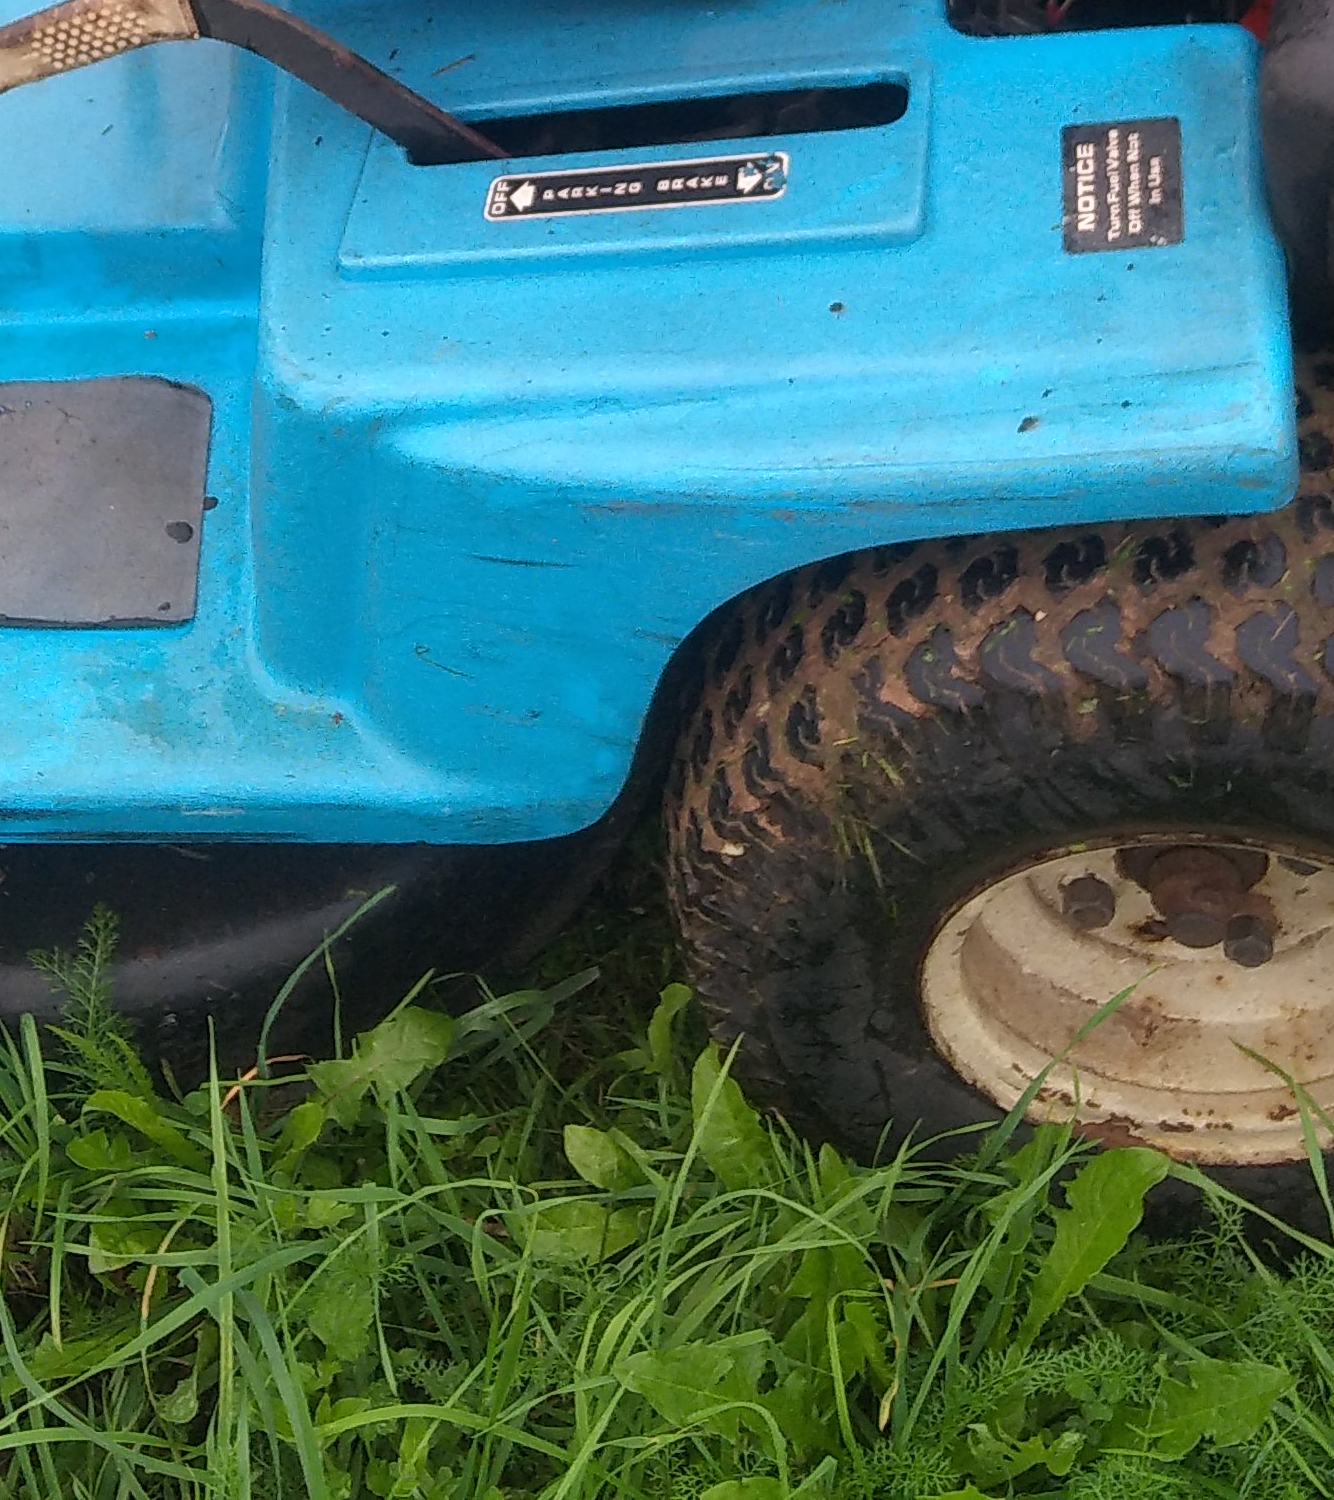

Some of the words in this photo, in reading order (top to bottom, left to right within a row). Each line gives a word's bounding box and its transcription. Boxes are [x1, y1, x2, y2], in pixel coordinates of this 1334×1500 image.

[1105, 128, 1120, 171] Valve
[491, 181, 510, 215] OFF
[543, 181, 642, 200] PARKING
[657, 175, 730, 192] BRAKE
[1076, 143, 1095, 232] NOTICE
[1107, 171, 1122, 203] Fuel
[1128, 164, 1142, 207] When
[1107, 204, 1122, 242] Turn
[1128, 209, 1144, 234] Off
